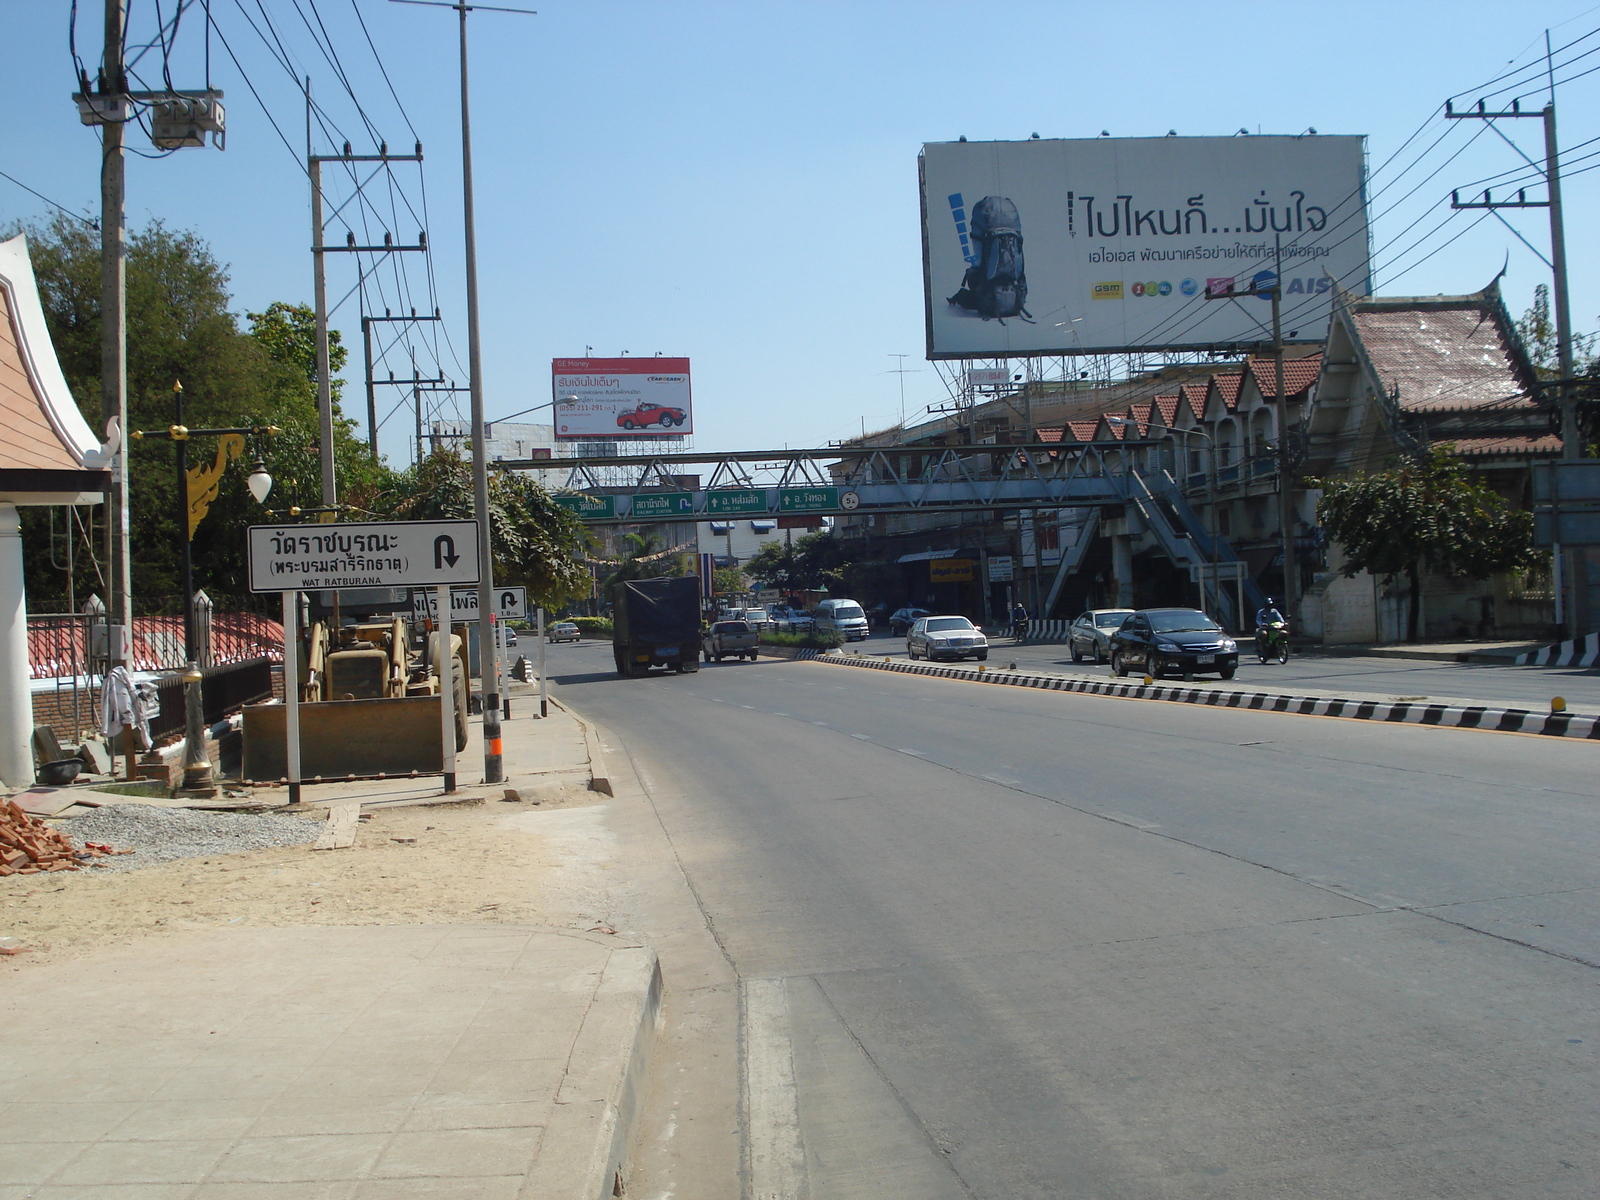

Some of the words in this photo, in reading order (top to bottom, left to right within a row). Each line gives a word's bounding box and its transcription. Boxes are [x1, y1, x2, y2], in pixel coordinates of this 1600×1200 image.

[1089, 247, 1136, 264] เอไอเอส
[1286, 277, 1331, 295] AIS
[636, 497, 670, 509] สถานีรถไฟ
[731, 493, 759, 504] หล่มสัก
[803, 492, 827, 502] วังทอง
[269, 531, 399, 559] วัดราชบูรณะ
[269, 555, 409, 577] (พระบรมสารีริกธาตุ)
[302, 578, 320, 587] WAT
[325, 576, 382, 586] RATBURANA
